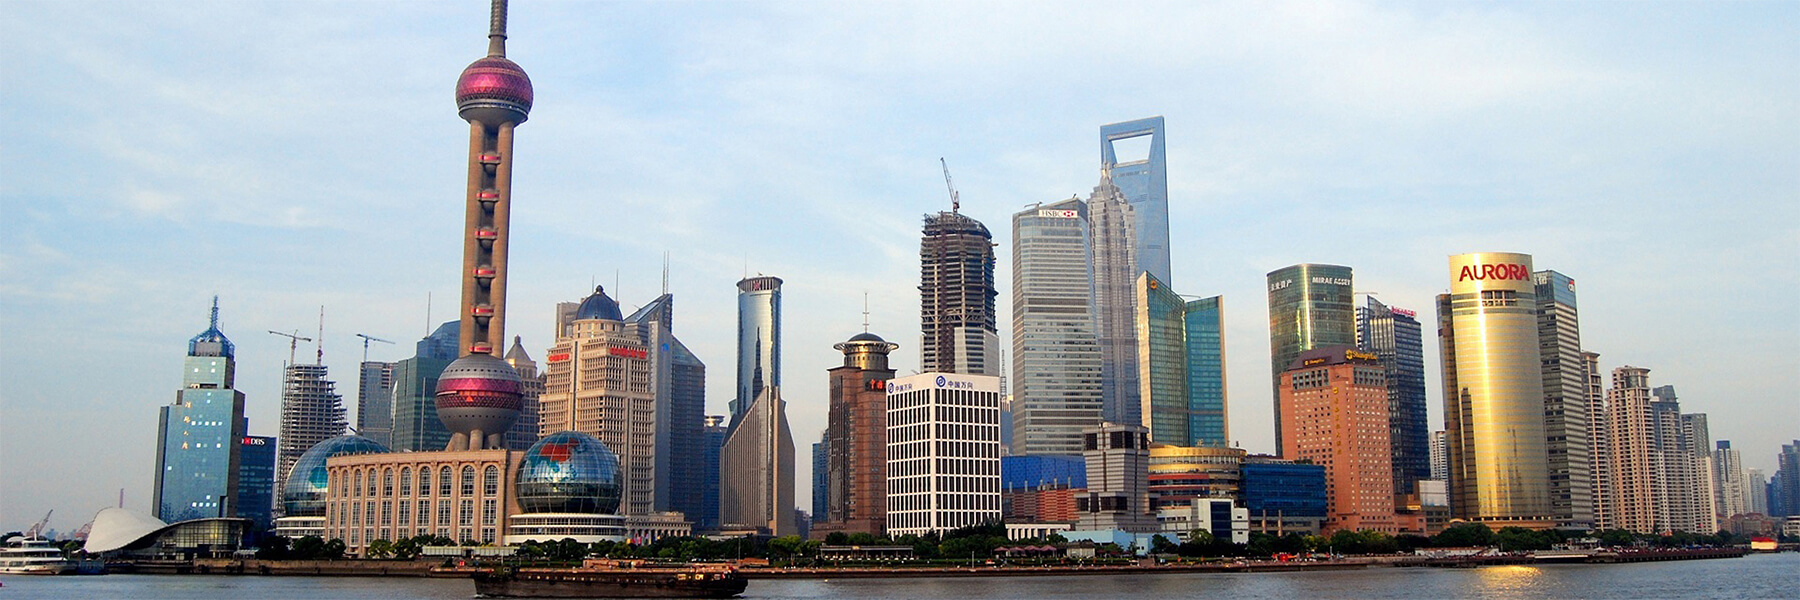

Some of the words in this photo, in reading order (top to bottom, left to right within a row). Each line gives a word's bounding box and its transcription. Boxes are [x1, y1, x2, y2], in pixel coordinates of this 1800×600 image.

[1459, 264, 1530, 281] AURORA
[948, 380, 974, 389] 中国万向
